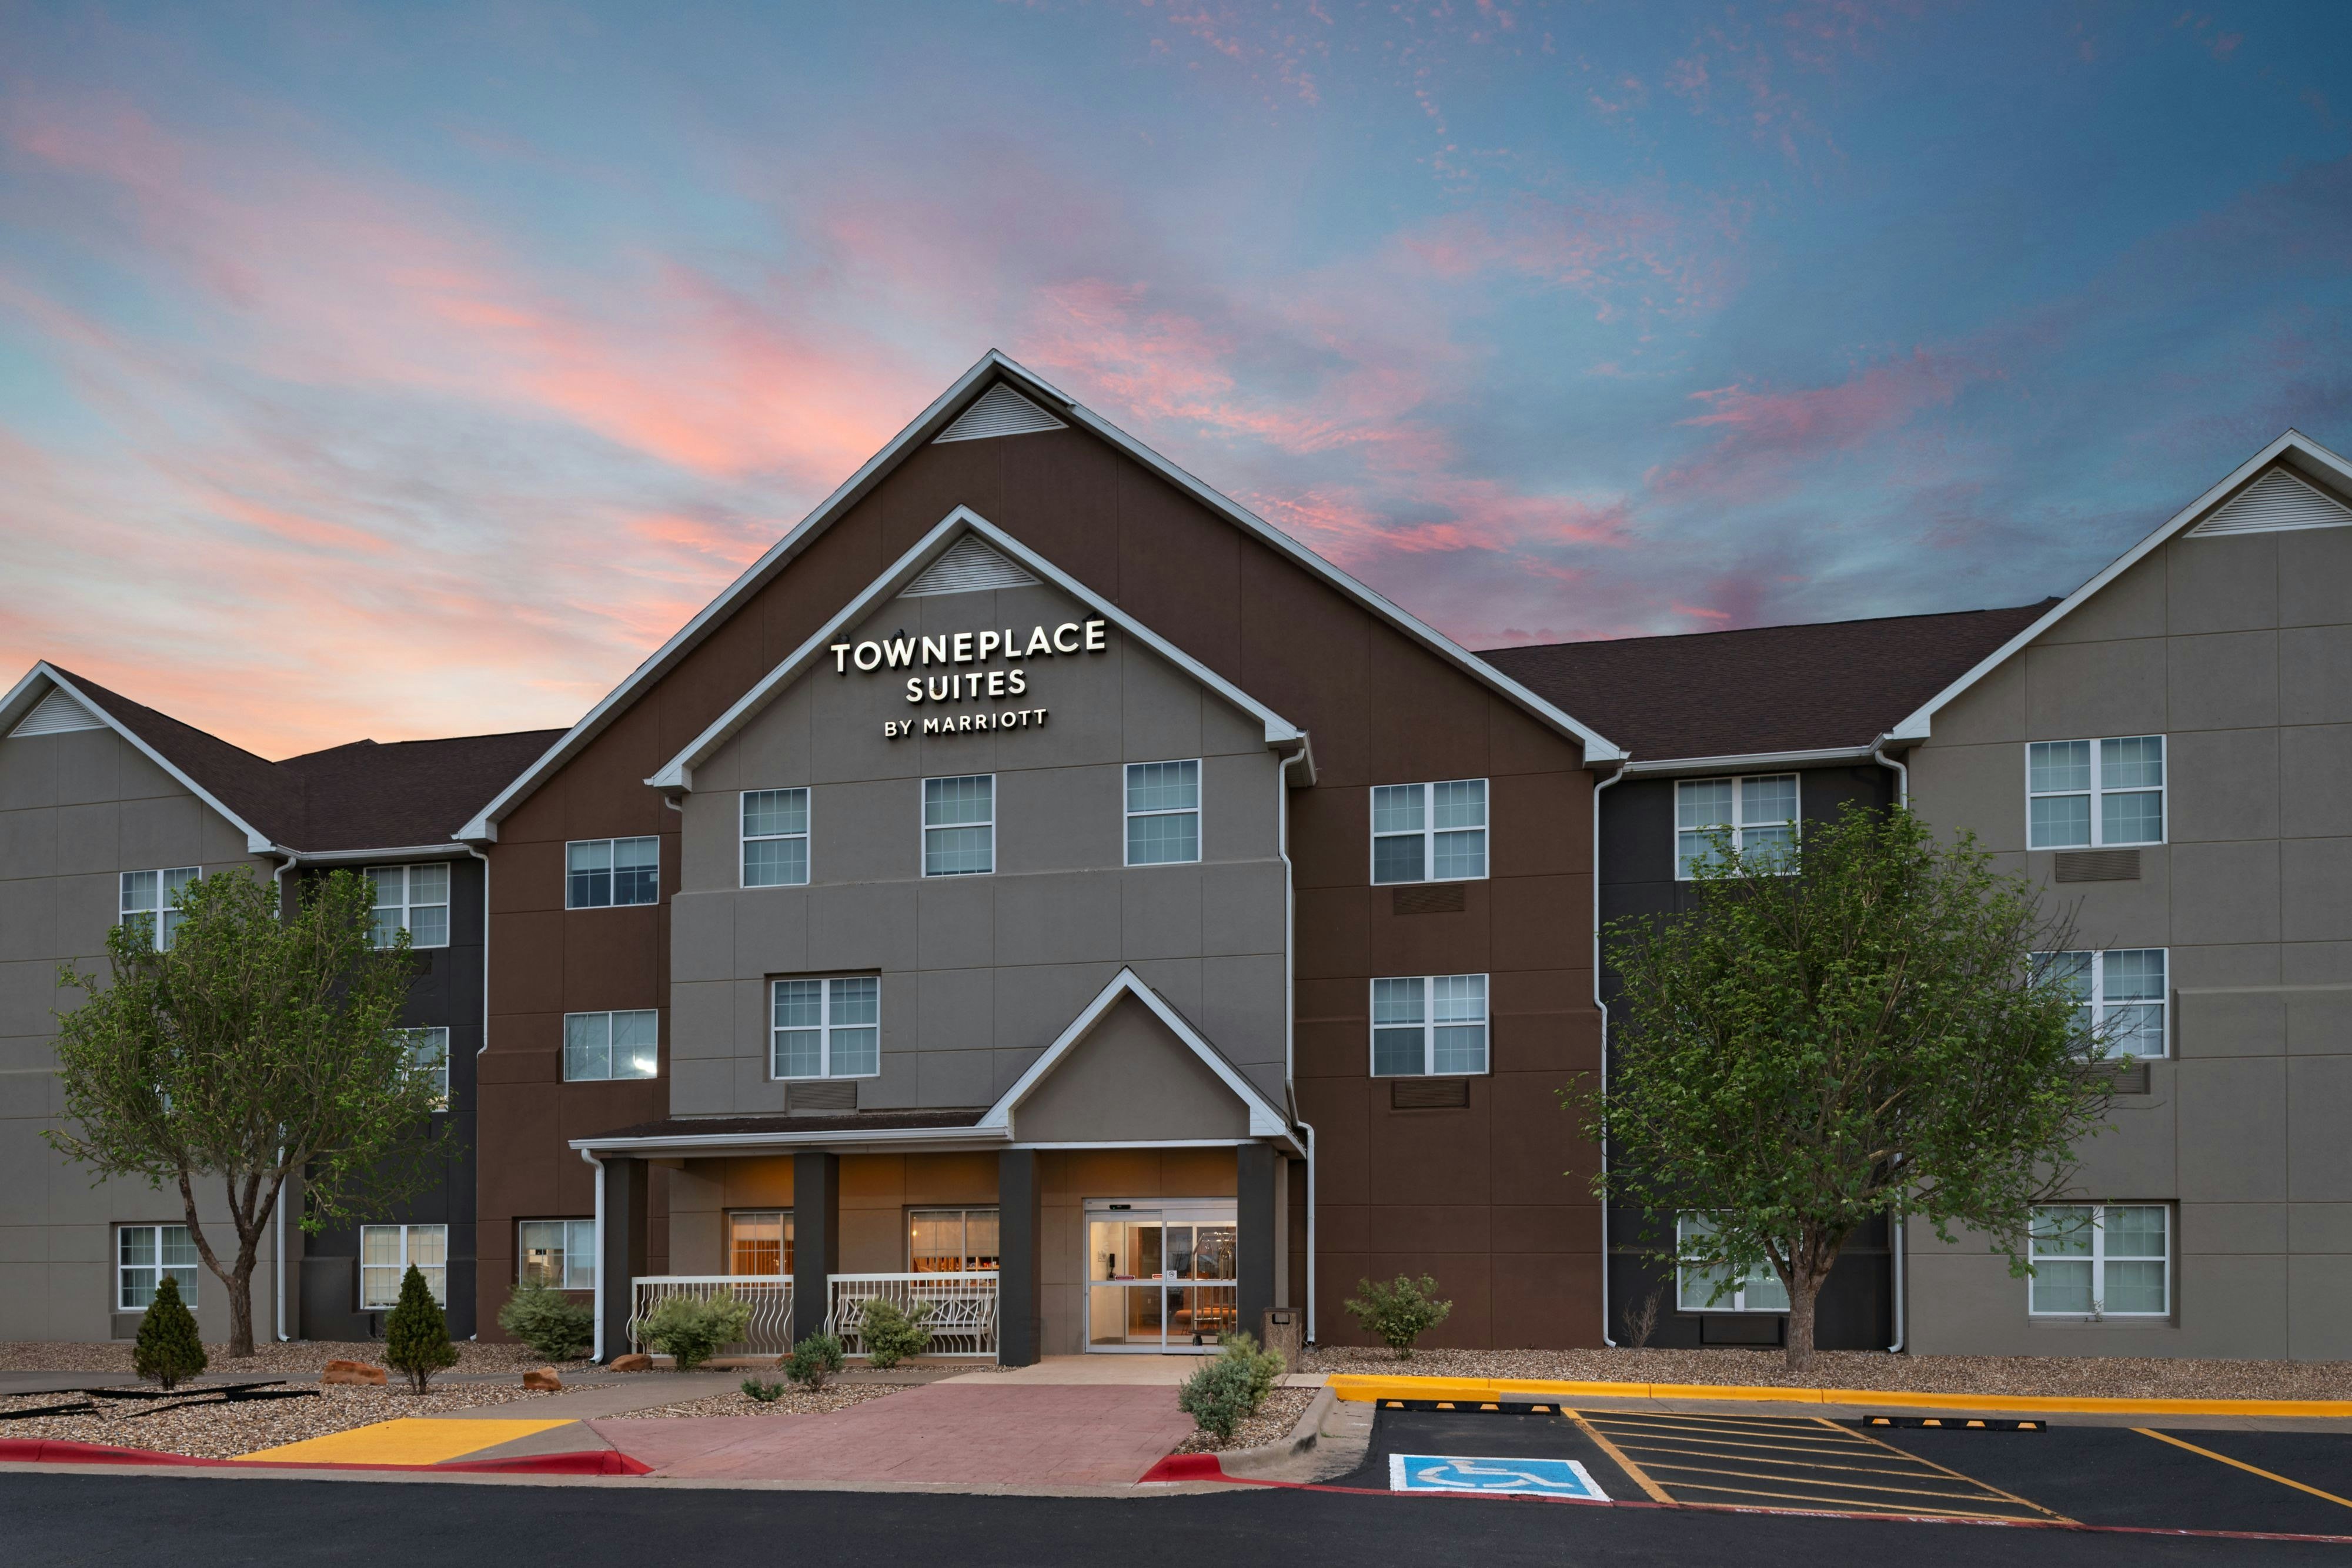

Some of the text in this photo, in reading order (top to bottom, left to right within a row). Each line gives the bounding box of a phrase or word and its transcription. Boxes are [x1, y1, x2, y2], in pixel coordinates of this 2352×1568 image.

[831, 620, 1106, 673] TOWNEPLACE
[906, 669, 1027, 703] SUITES
[885, 708, 1047, 737] BY MARRIOTT
